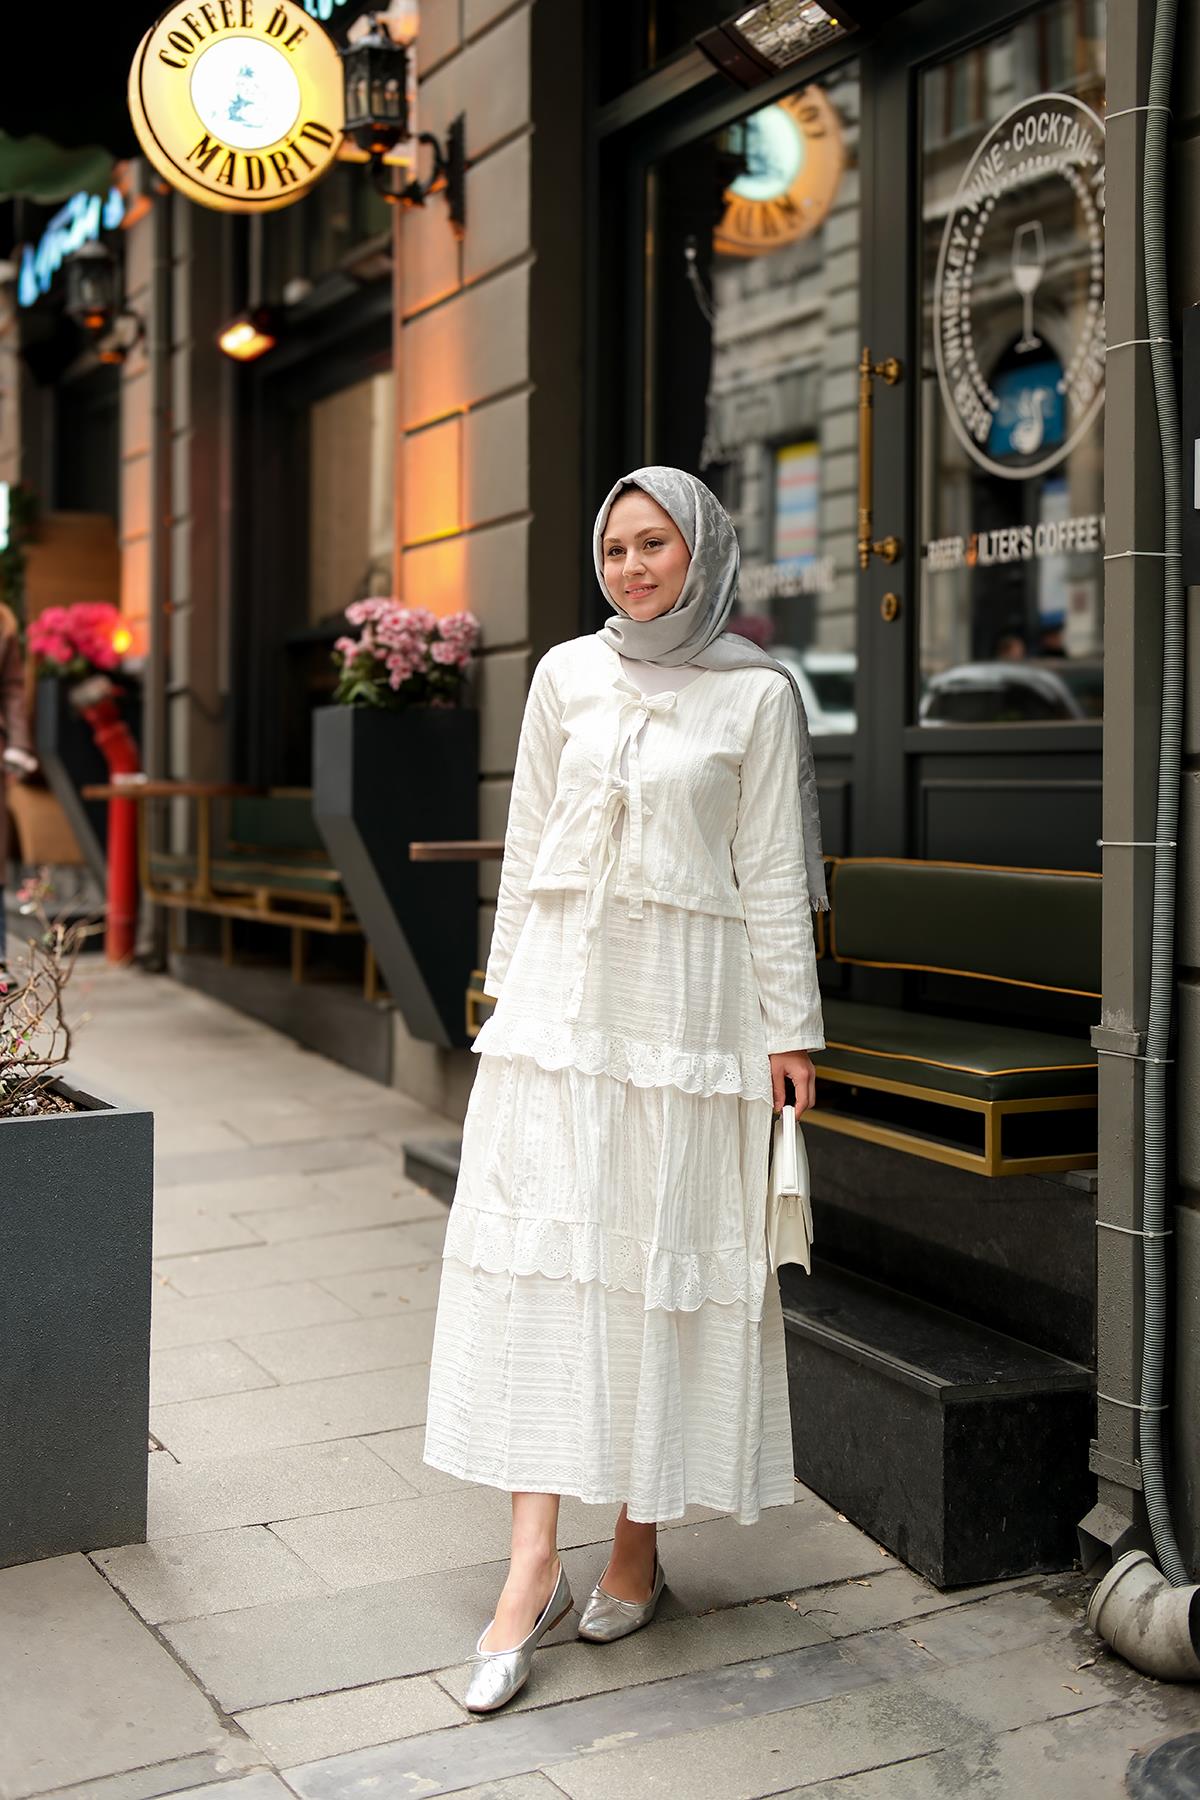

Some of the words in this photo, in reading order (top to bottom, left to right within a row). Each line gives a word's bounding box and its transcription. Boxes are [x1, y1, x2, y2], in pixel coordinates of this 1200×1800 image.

[159, 0, 253, 69] COFFEE
[265, 6, 309, 52] DE
[186, 121, 337, 191] MADRID
[942, 226, 967, 369] WHISKEY
[1034, 516, 1099, 555] COFFEE
